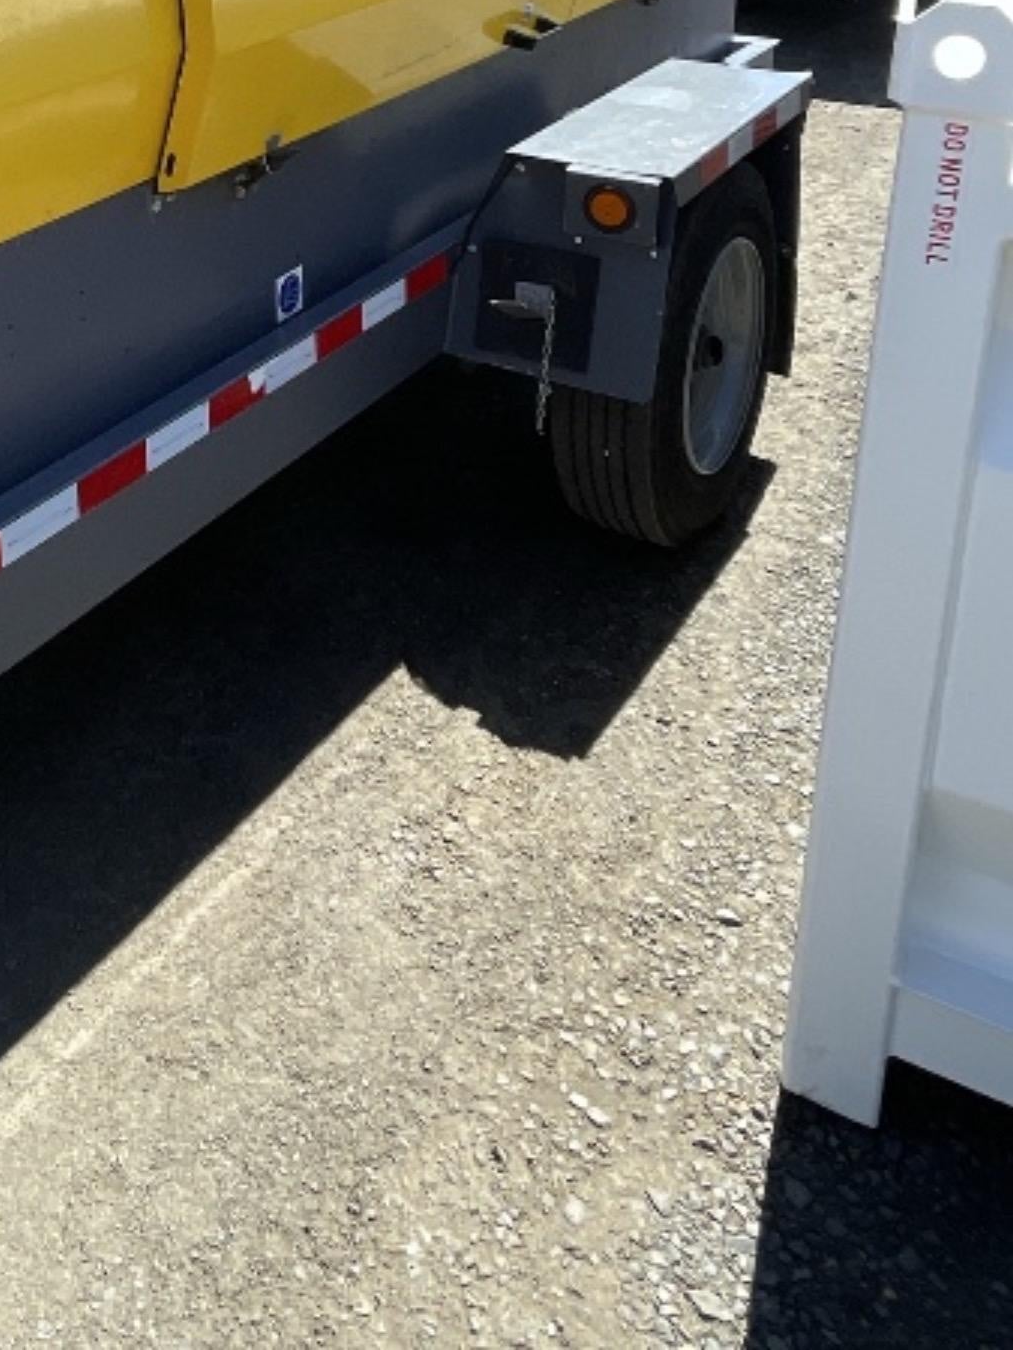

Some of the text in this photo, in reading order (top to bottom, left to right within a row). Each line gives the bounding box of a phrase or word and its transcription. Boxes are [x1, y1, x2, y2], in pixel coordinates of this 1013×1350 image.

[925, 121, 970, 265] DO NOT DRILL
